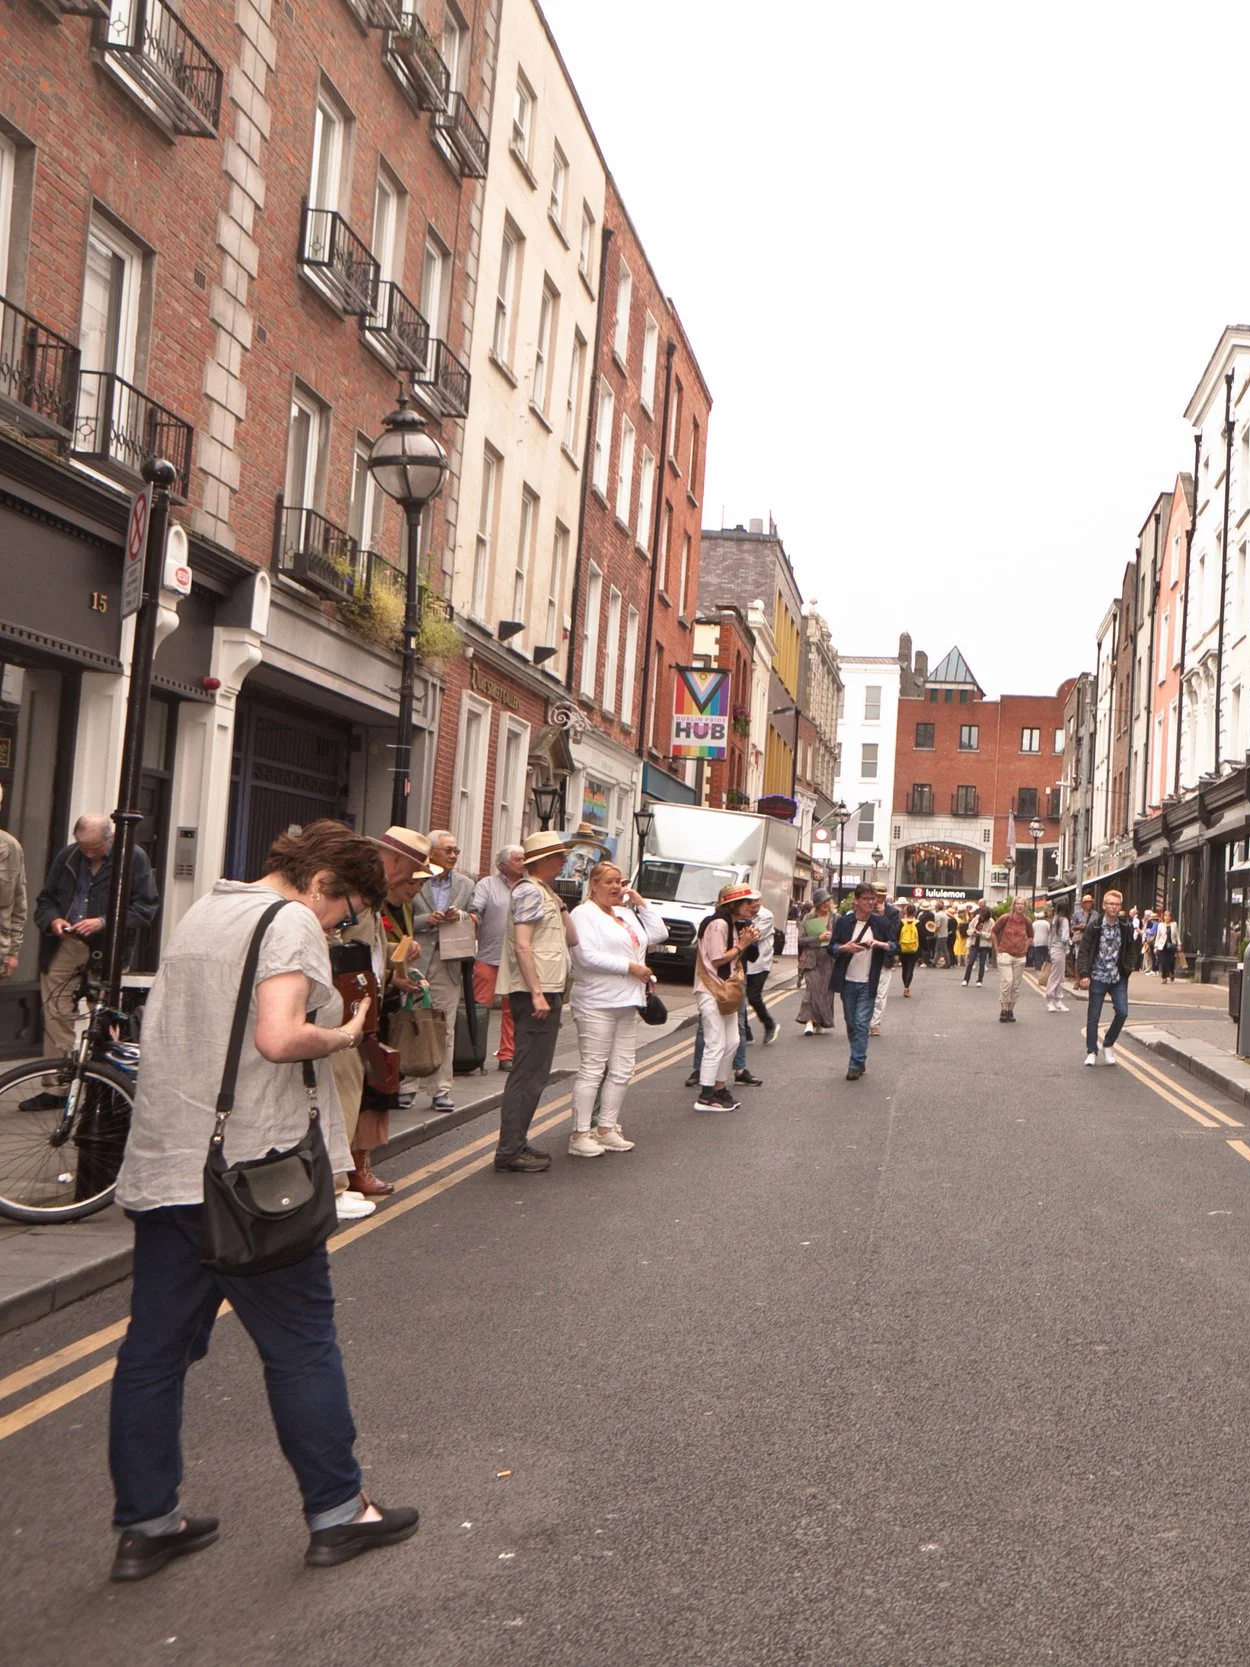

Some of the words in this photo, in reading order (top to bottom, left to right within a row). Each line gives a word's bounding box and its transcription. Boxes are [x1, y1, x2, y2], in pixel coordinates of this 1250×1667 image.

[91, 591, 108, 613] 15
[675, 721, 725, 740] HUB
[926, 888, 965, 899] lululemon
